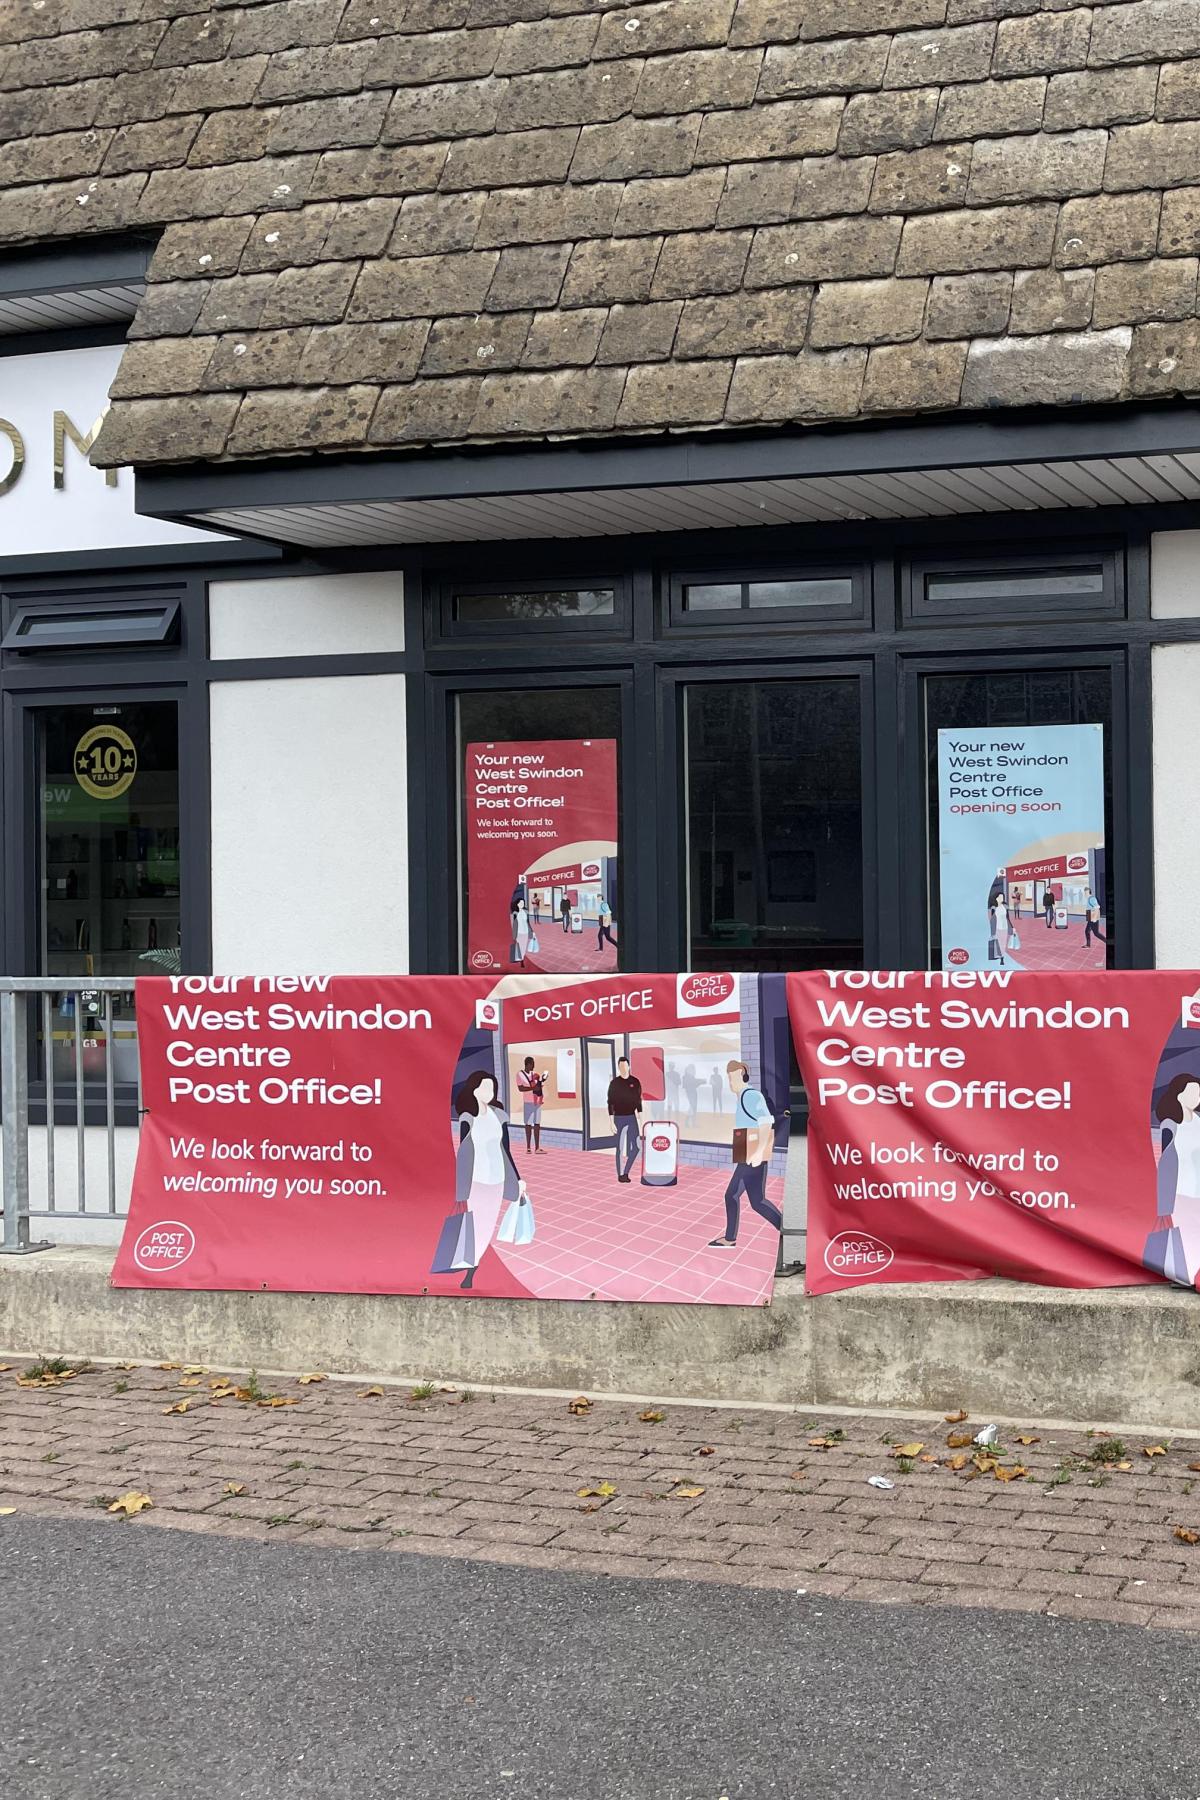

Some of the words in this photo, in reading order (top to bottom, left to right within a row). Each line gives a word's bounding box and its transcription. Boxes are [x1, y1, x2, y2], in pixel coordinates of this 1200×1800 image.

[949, 741, 986, 753] Your
[990, 741, 1025, 751] new
[90, 746, 121, 773] 10
[475, 754, 509, 765] Your
[513, 755, 544, 764] new
[949, 756, 992, 768] West
[996, 754, 1068, 766] Swindon
[92, 773, 119, 781] YEARS
[475, 769, 516, 780] West
[518, 767, 584, 779] Swindon
[949, 772, 1007, 783] Centre
[476, 783, 528, 794] Centre
[949, 787, 987, 798] Post
[991, 785, 1043, 797] Office
[476, 798, 511, 809] Post
[513, 796, 565, 808] Office!
[950, 803, 1017, 815] opening
[1020, 801, 1061, 812] soon
[477, 819, 491, 827] We
[492, 818, 509, 827] look
[511, 817, 543, 826] forward
[544, 818, 553, 826] to
[477, 830, 519, 840] welcoming
[520, 831, 535, 840] you
[537, 830, 558, 838] soon.
[533, 875, 550, 883] POST
[551, 870, 575, 880] OFFICE
[1014, 868, 1032, 876] POST
[1034, 863, 1059, 873] OFFICE
[168, 976, 245, 994] Your
[253, 975, 331, 993] new
[692, 975, 724, 988] POST
[823, 970, 914, 989] Your
[924, 970, 1014, 988] new
[685, 985, 727, 1000] OFFICE
[523, 1002, 574, 1023] POST
[580, 989, 654, 1016] OFFICE
[163, 1004, 260, 1031] West
[267, 1003, 432, 1030] Swindon
[816, 1000, 930, 1028] West
[940, 1000, 1129, 1029] Swindon
[166, 1040, 291, 1067] Centre
[816, 1038, 965, 1068] Centre
[169, 1077, 250, 1104] Post
[259, 1078, 382, 1105] Office!
[818, 1078, 914, 1107] Post
[925, 1080, 1072, 1110] Office!
[169, 1137, 205, 1160] We
[211, 1138, 255, 1160] look
[260, 1139, 344, 1162] forward
[350, 1143, 372, 1162] to
[826, 1143, 863, 1166] We
[870, 1141, 925, 1165] look
[932, 1142, 1025, 1171] forward
[1033, 1150, 1059, 1172] to
[163, 1172, 277, 1199] welcoming
[284, 1176, 323, 1199] you
[329, 1177, 388, 1196] soon.
[834, 1176, 957, 1202] welcoming
[965, 1180, 1004, 1201] yo
[1009, 1190, 1076, 1209] soon.
[151, 1232, 184, 1245] POST
[140, 1245, 186, 1259] OFFICE
[842, 1240, 875, 1252] POST
[832, 1249, 886, 1267] OFFICE
